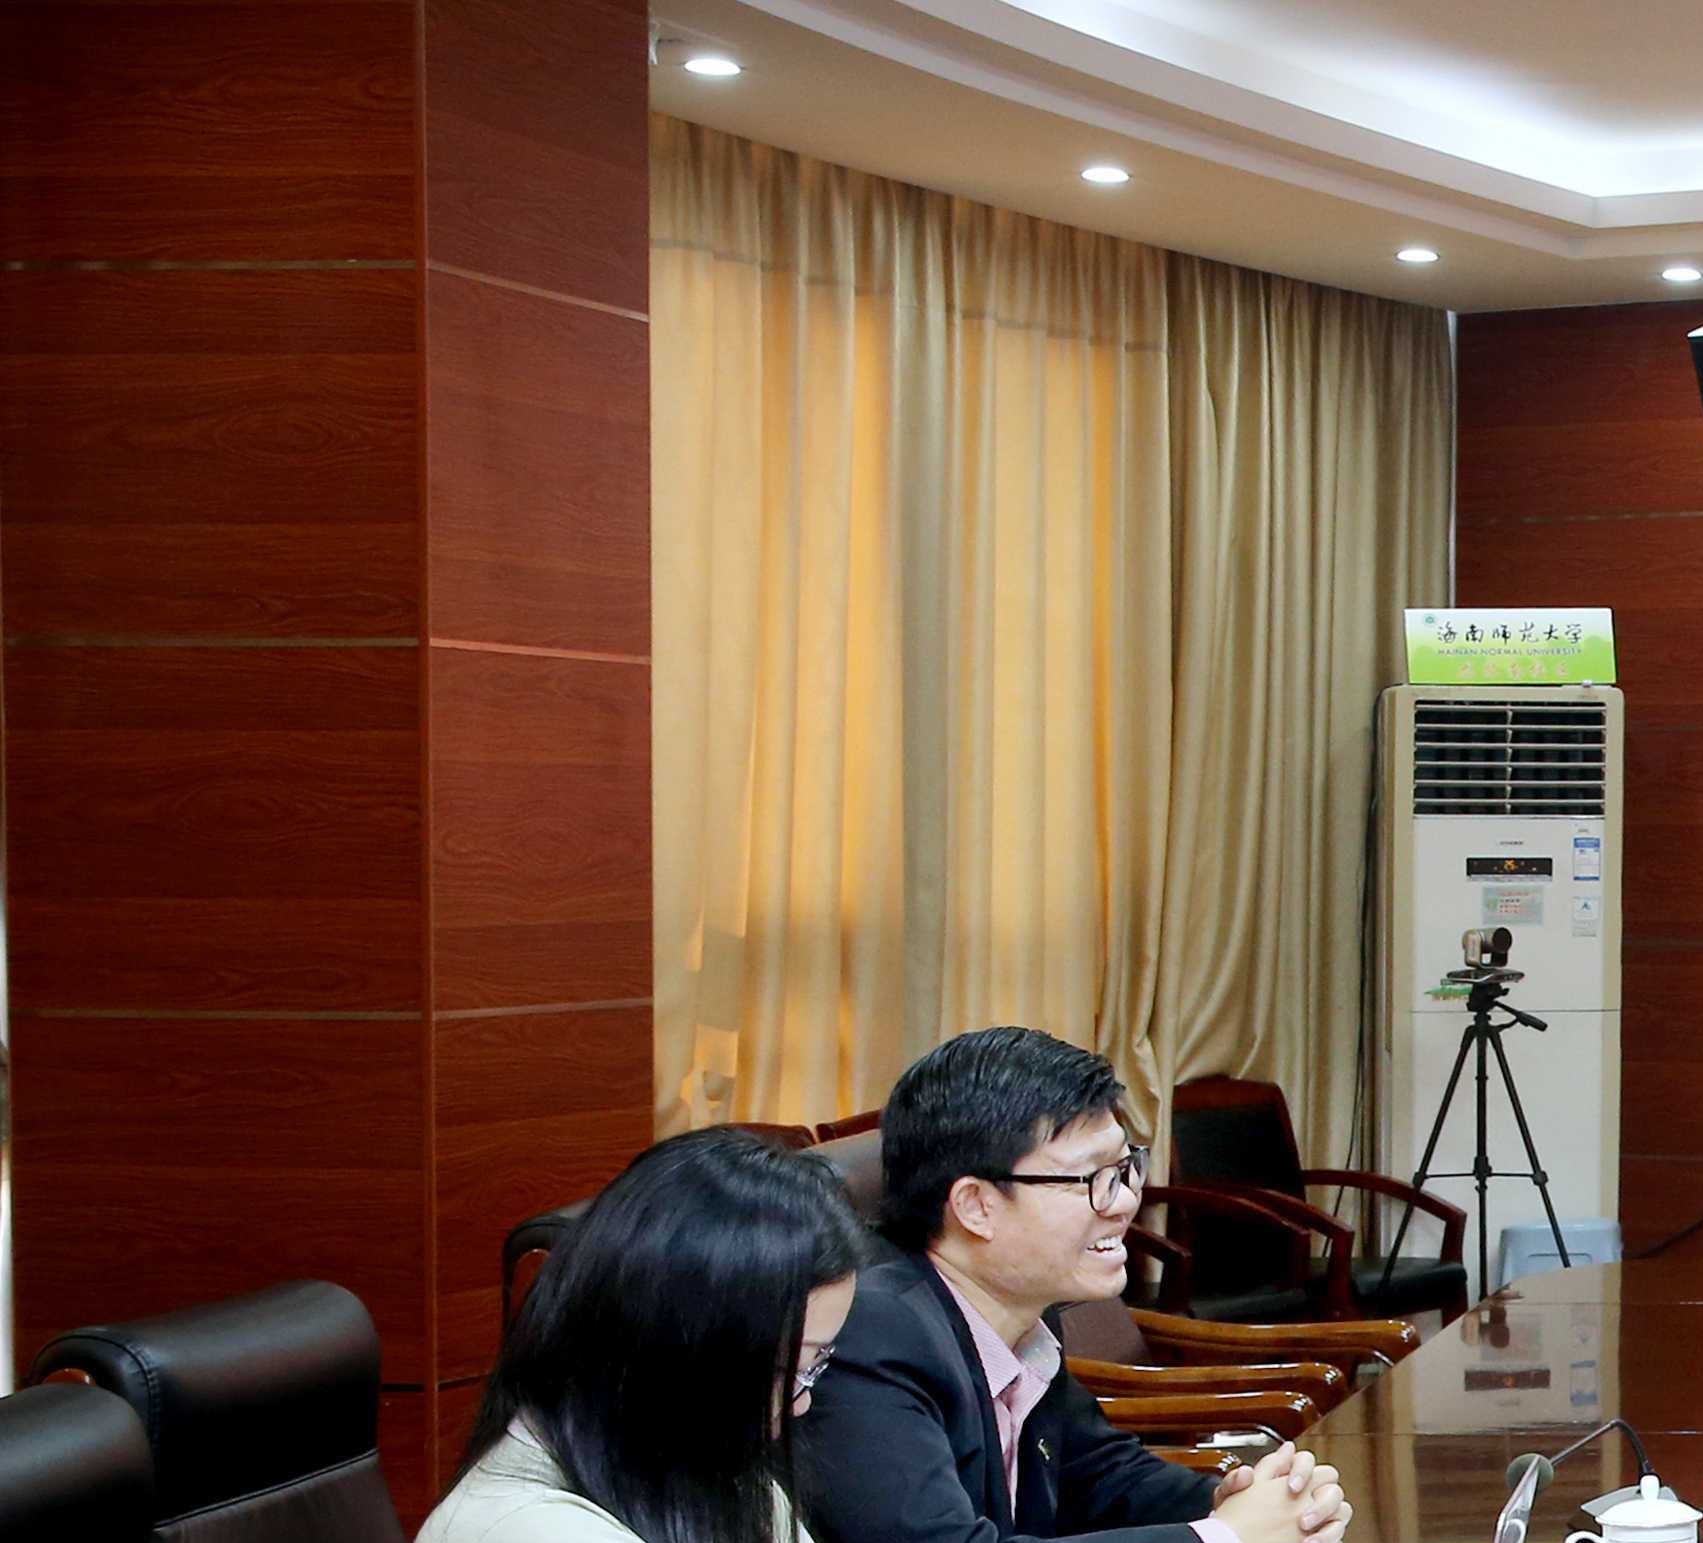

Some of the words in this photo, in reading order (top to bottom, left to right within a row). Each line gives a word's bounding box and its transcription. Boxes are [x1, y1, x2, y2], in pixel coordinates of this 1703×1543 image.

[1437, 621, 1583, 645] 海南师范大学
[1481, 648, 1522, 656] NORMAL
[1526, 648, 1582, 656] UNIVERSITY
